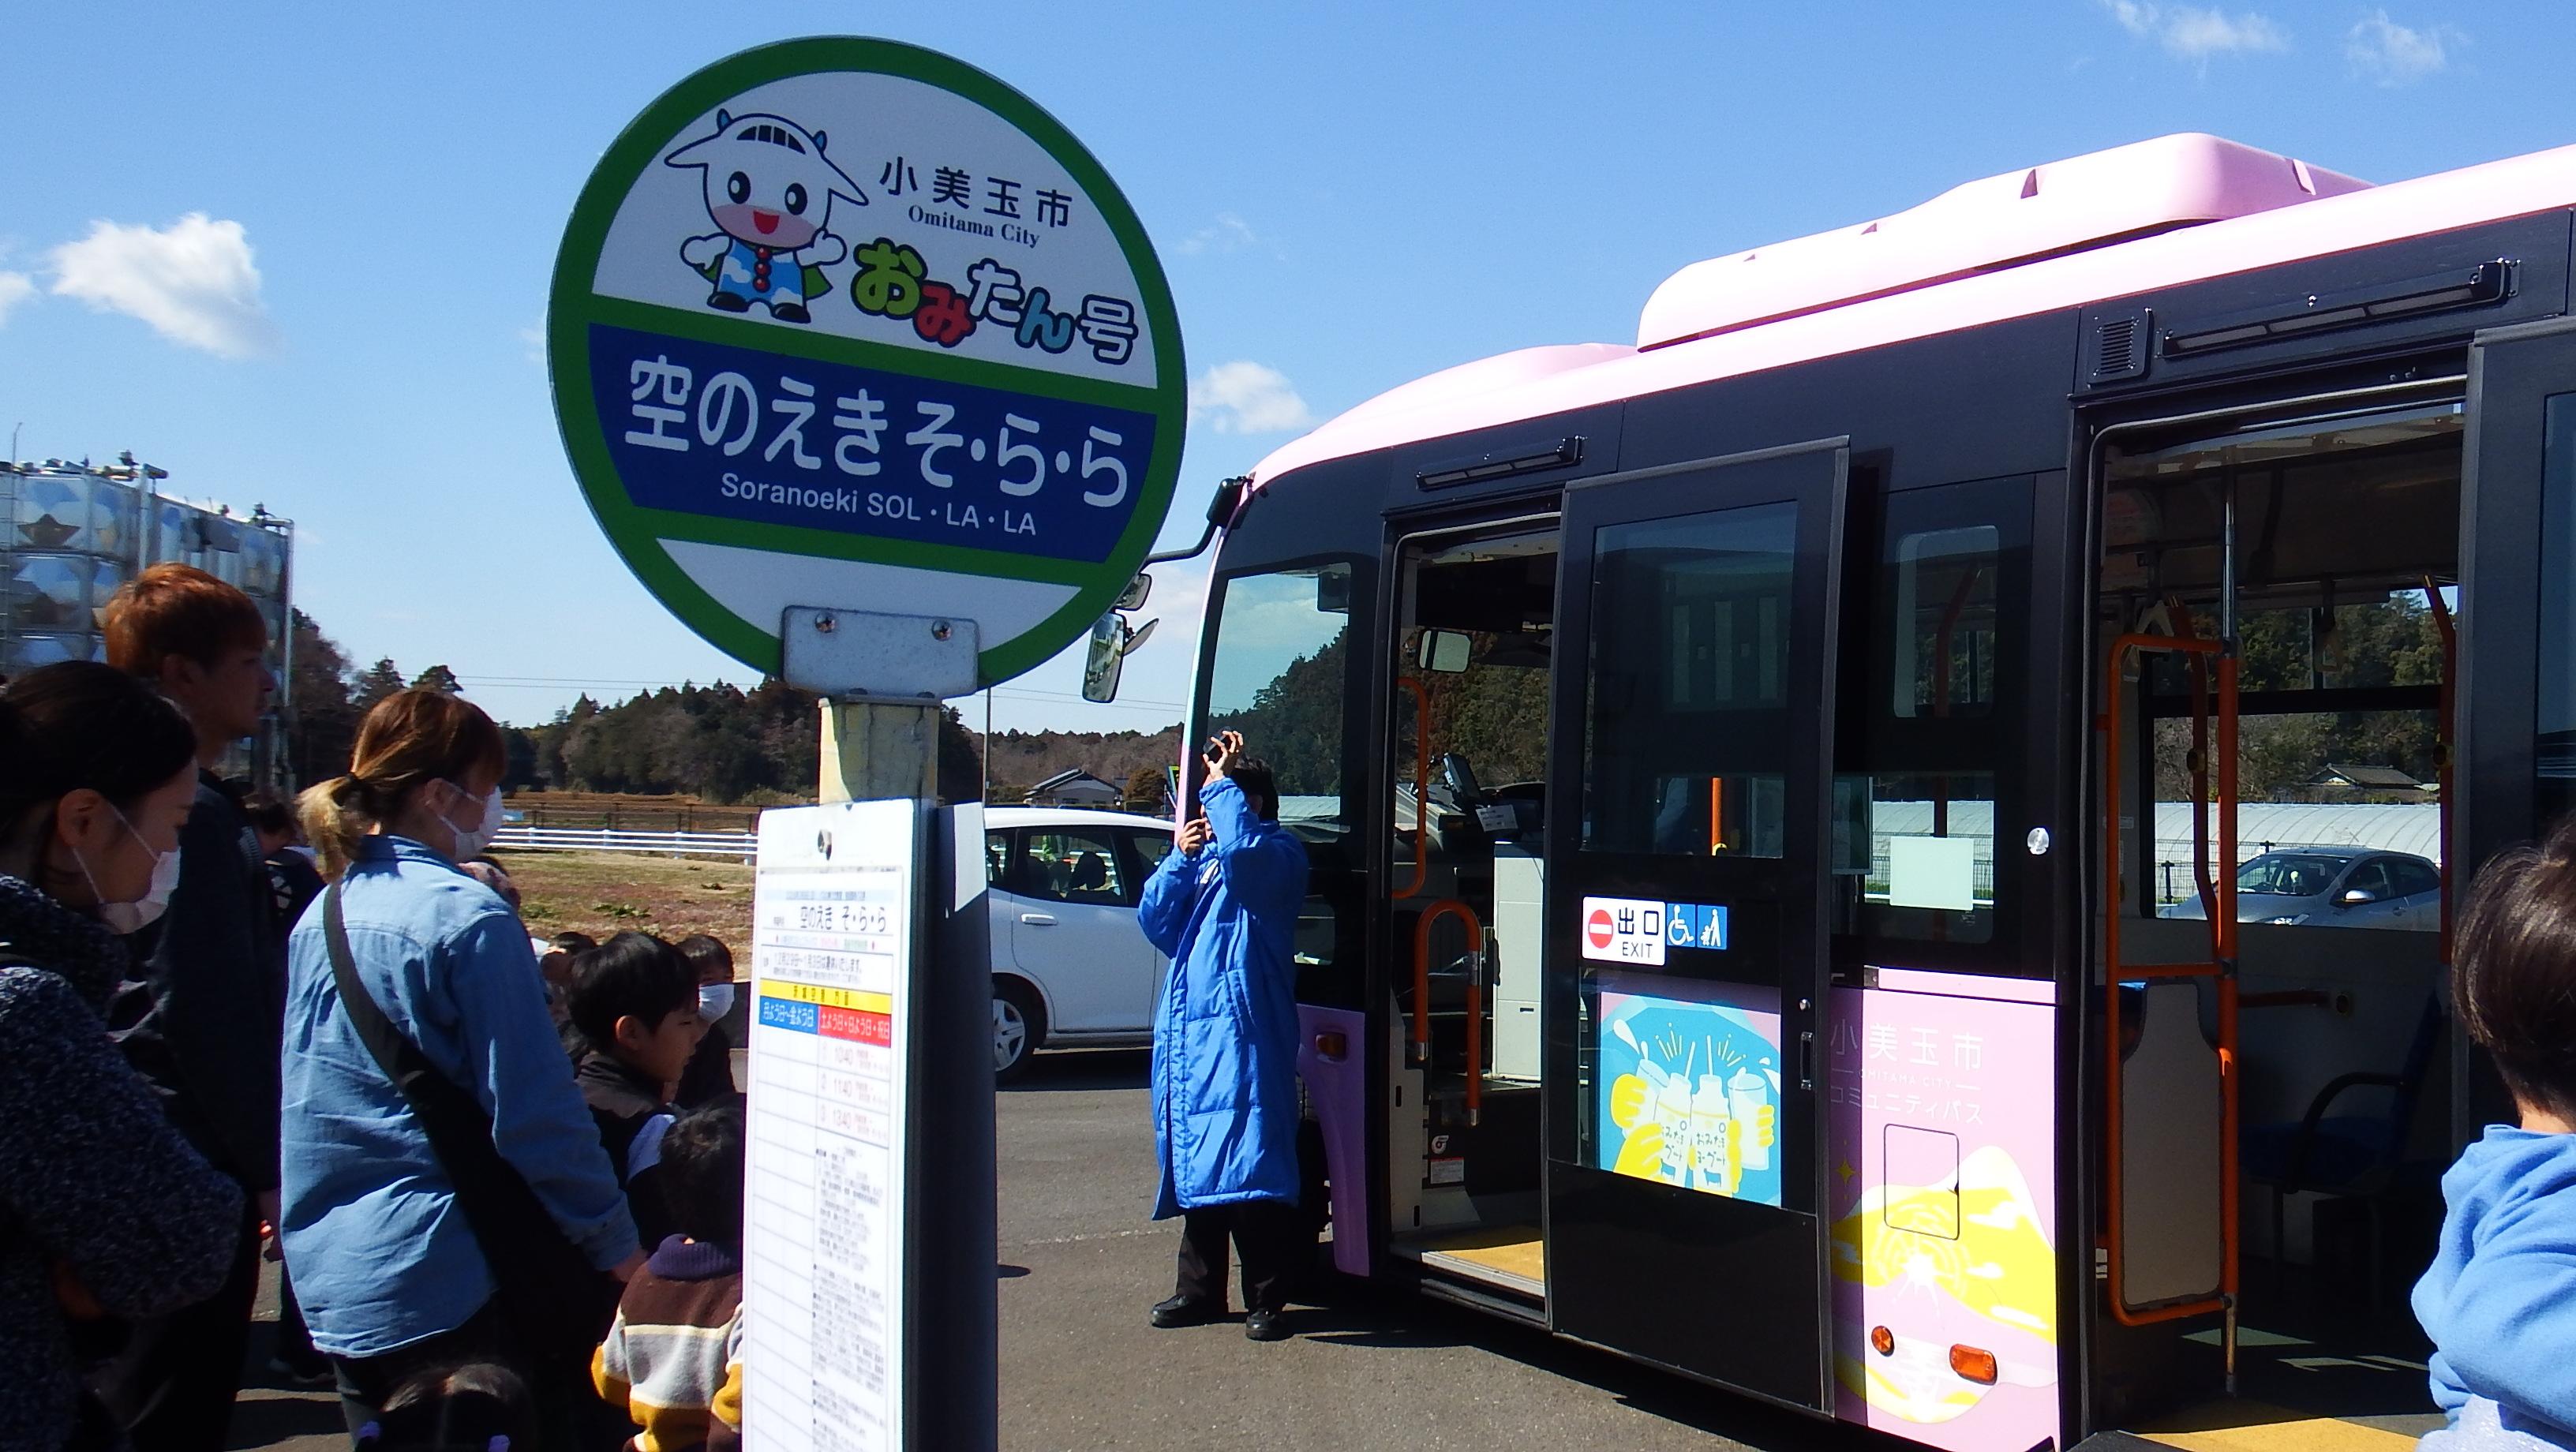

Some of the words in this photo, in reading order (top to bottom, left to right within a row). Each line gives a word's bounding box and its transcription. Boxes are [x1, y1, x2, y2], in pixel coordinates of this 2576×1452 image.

[878, 155, 1073, 228] 小美玉市
[908, 204, 994, 238] Omitama
[1001, 223, 1040, 249] City
[850, 236, 1140, 366] おみたん号
[721, 473, 858, 514] Soranoeki
[1617, 906, 1660, 937] 出口
[1622, 941, 1653, 959] EXIT
[1829, 1018, 1984, 1071] 小美玉市
[1923, 1074, 1953, 1089] CITY
[1829, 1084, 1984, 1125] コミュニティバス
